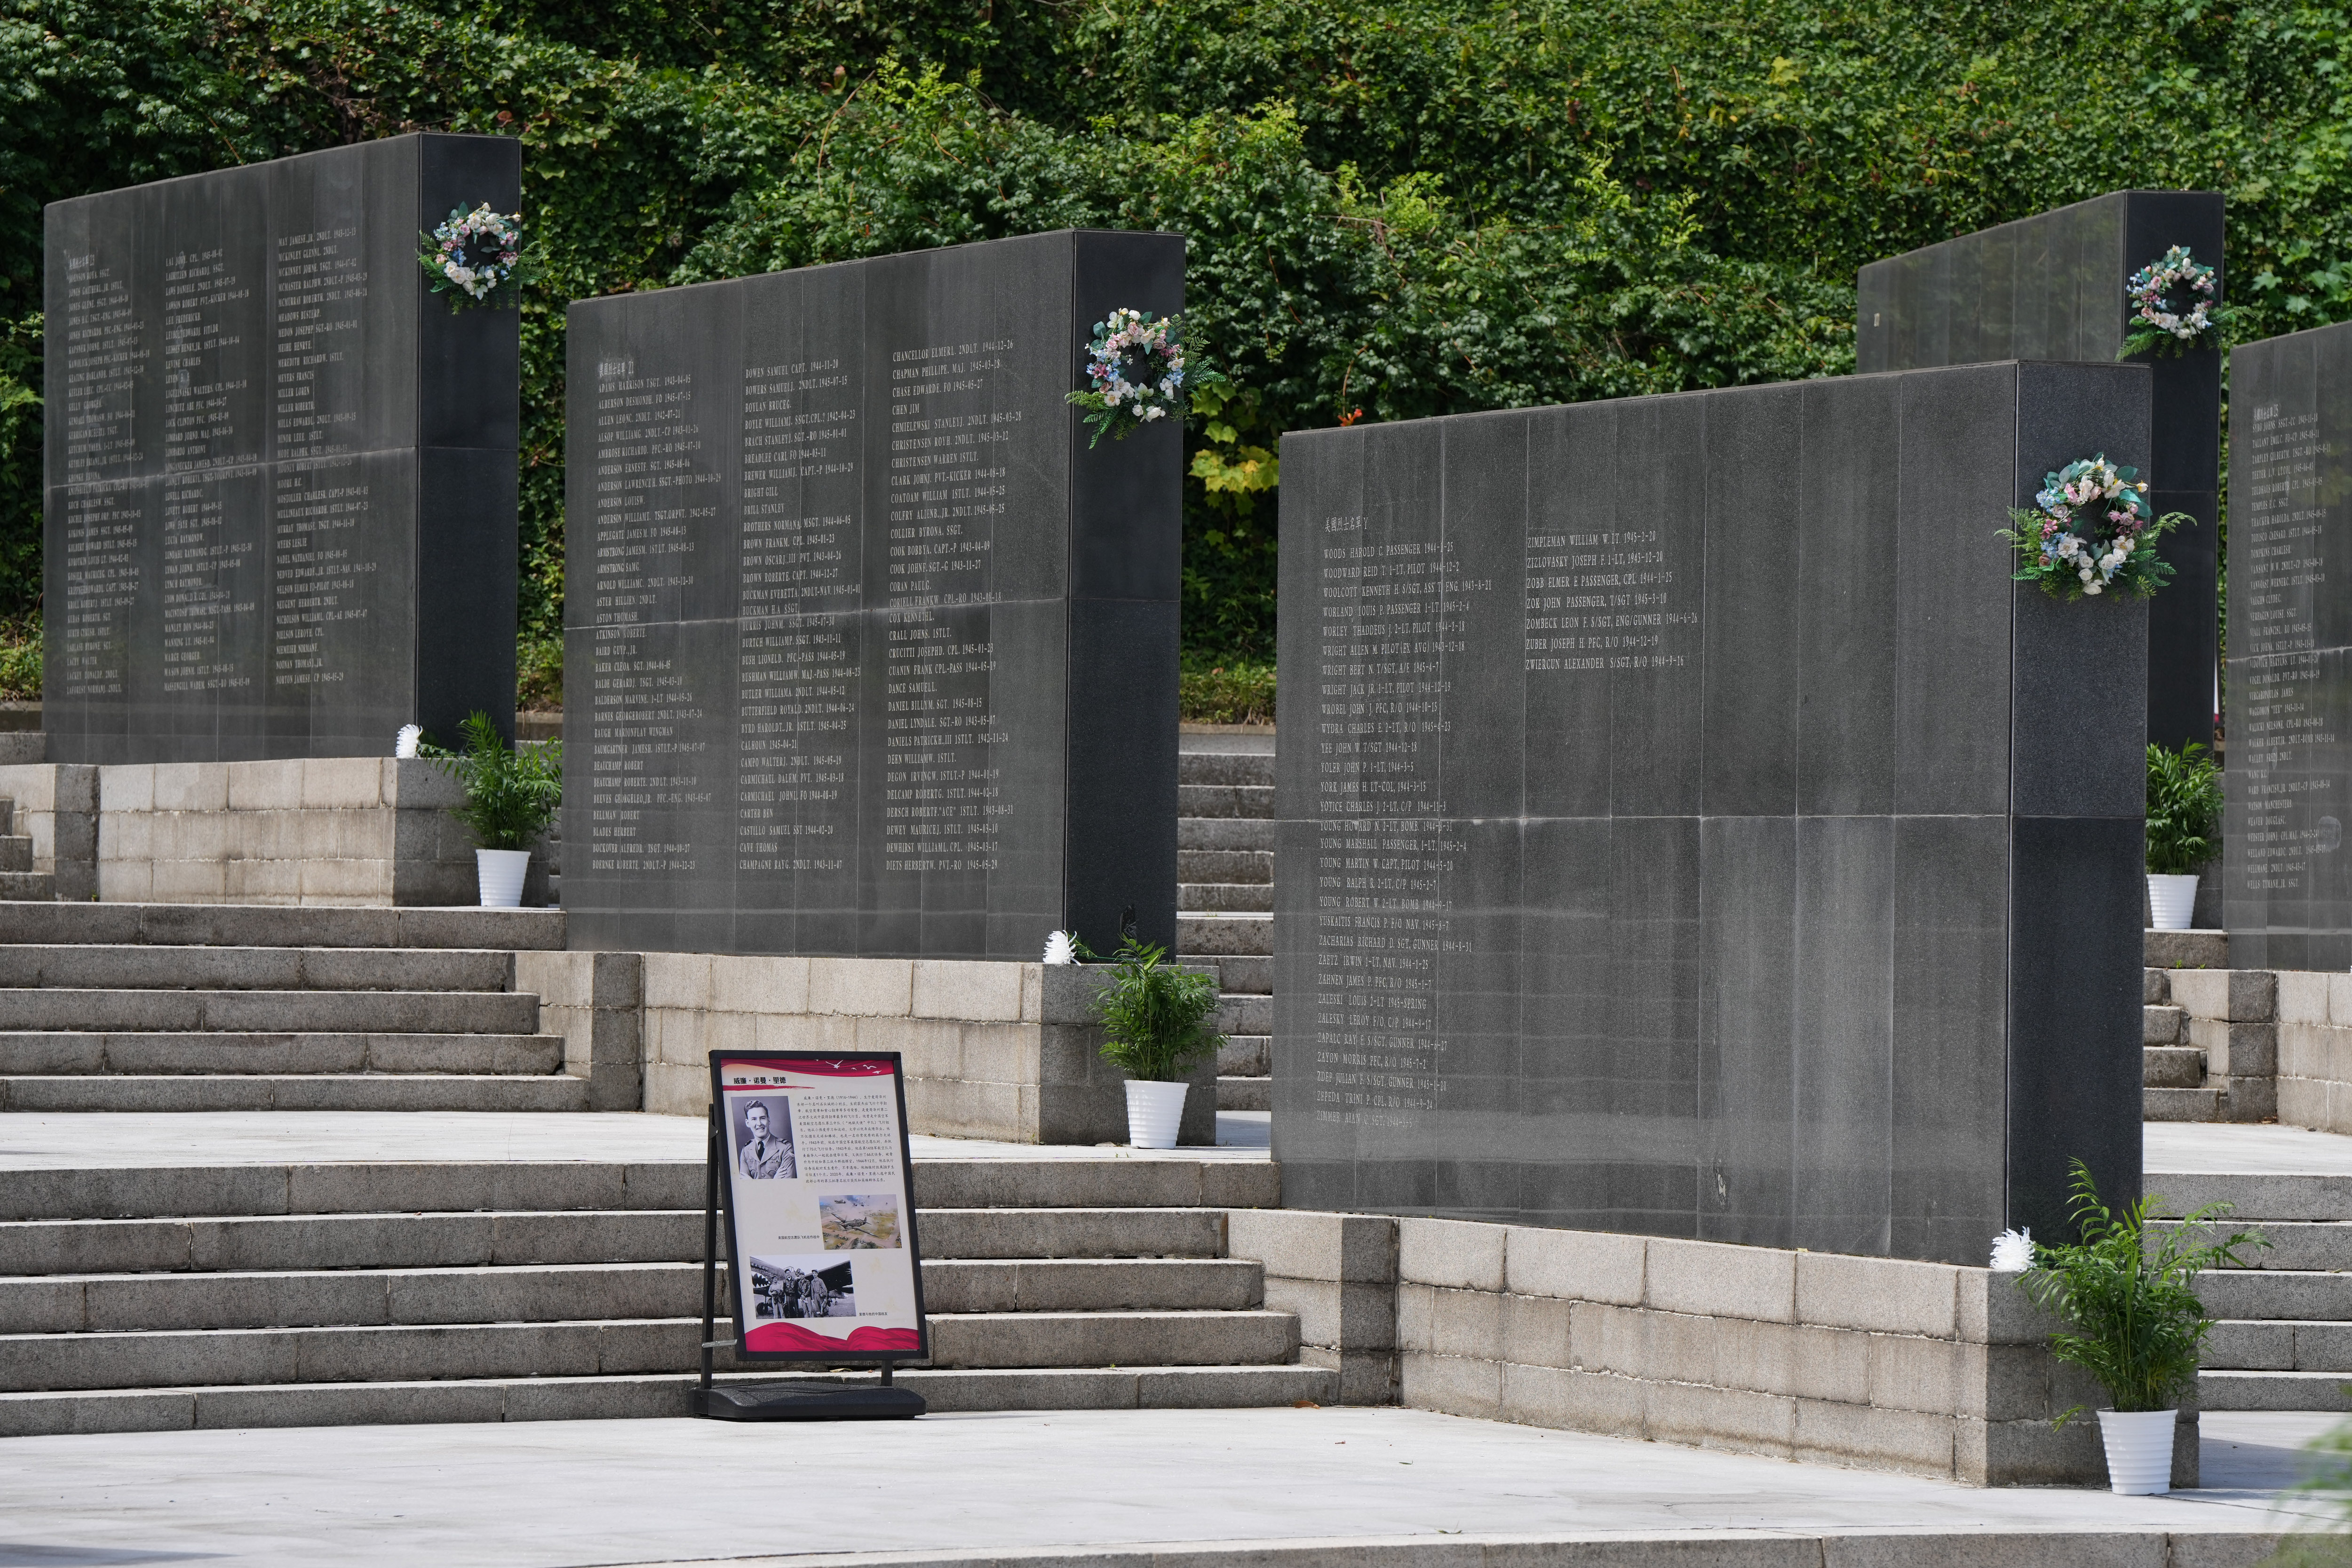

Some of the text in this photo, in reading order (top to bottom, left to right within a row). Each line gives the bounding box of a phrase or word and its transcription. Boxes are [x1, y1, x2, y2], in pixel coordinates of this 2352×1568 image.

[893, 340, 1013, 361] CHANCELLOR ELMERL. 2NDLT. 1944-12-26
[746, 359, 838, 378] BOWEN SAMUEL CAPT. 1944-11-20
[893, 386, 911, 397] CHASE
[944, 382, 951, 392] FO
[954, 379, 983, 391] 1945-05-27
[892, 404, 920, 415] CHEN JIM
[598, 432, 613, 442] ALSOP
[1325, 516, 1361, 533] 美國烈士名單
[1527, 535, 1565, 548] ZIMPLEMAN
[1570, 533, 1598, 546] WILLIAM
[1603, 533, 1610, 544] W.
[1624, 531, 1655, 542] 1945-2-20
[1324, 548, 1345, 558] WOODS
[1350, 546, 1375, 557] HAROLD
[1379, 546, 1383, 556] C.
[1386, 543, 1421, 555] PASSENGER
[1527, 556, 1567, 568] ZIZLOVASKY
[1572, 554, 1597, 569] JOSEPH
[1601, 554, 1605, 565] F.
[1628, 551, 1663, 563] 1943-12-20
[1527, 578, 1544, 588] ZOBB
[1548, 576, 1569, 587] ELMER
[1574, 576, 1579, 586] E.
[1581, 574, 1621, 586] PASSENGER,
[1640, 572, 1672, 583] 1944-1-25
[1527, 593, 1667, 611] ZOK JOHN PASSENGER, T/SGT 1945-3-10
[1526, 618, 1557, 629] ZOMBECK
[1561, 617, 1579, 628] LEON
[1583, 617, 1588, 627] F.
[1615, 614, 1661, 626] ENG/GUNNER
[1666, 613, 1698, 624] 1944-6-26
[1526, 639, 1547, 649] ZUBER
[1550, 638, 1575, 652] JOSEPH
[1605, 637, 1618, 647] R/O
[1623, 636, 1658, 647] 1944-12-19
[1322, 665, 1346, 675] WRIGHT
[1350, 664, 1365, 675] BERT
[1368, 664, 1374, 674] N.
[1399, 663, 1410, 673] A/E
[1414, 662, 1439, 673] 1945-4-7
[1526, 659, 1560, 669] ZWIERCUN
[1564, 657, 1604, 669] ALEXANDER
[1634, 656, 1647, 667] R/O
[1652, 655, 1684, 666] 1944-9-16
[1322, 704, 1346, 714] WROBEL
[1349, 704, 1364, 716] JOHN
[1369, 703, 1373, 716] J.
[1391, 703, 1402, 713] R/O
[1406, 702, 1437, 713] 1944-10-15
[741, 740, 797, 750] CALHOUN 1945-04-21
[1321, 743, 1332, 753] YEE
[1335, 743, 1351, 756] JOHN
[1363, 742, 1382, 752] T/SGT
[1386, 742, 1417, 752] 1944-12-18
[1321, 763, 1340, 772] YOLER
[1343, 762, 1359, 775] JOHN
[1388, 762, 1414, 772] 1944-3-5
[1321, 782, 1337, 792] YORK
[1340, 782, 1359, 794] JAMES
[1362, 782, 1368, 792] H.
[1398, 782, 1426, 792] 1944-3-15
[740, 809, 773, 818] CARTER BEN
[593, 828, 636, 836] BLADES HERBERT
[887, 843, 914, 852] DEWHIRST
[950, 842, 962, 852] CPL.
[968, 842, 998, 852] 1945-03-17
[593, 860, 614, 869] BOERNKE
[617, 860, 640, 869] ROBERTE.
[669, 860, 695, 869] 1944-12-23
[1320, 877, 1341, 888] YOUNG
[1347, 878, 1366, 888] RALPH
[1396, 879, 1406, 890] C/P
[1411, 880, 1436, 890] 1945-2-7
[1318, 994, 1426, 1009] ZALESKI LOUIS 2-LT 1945-SPRING
